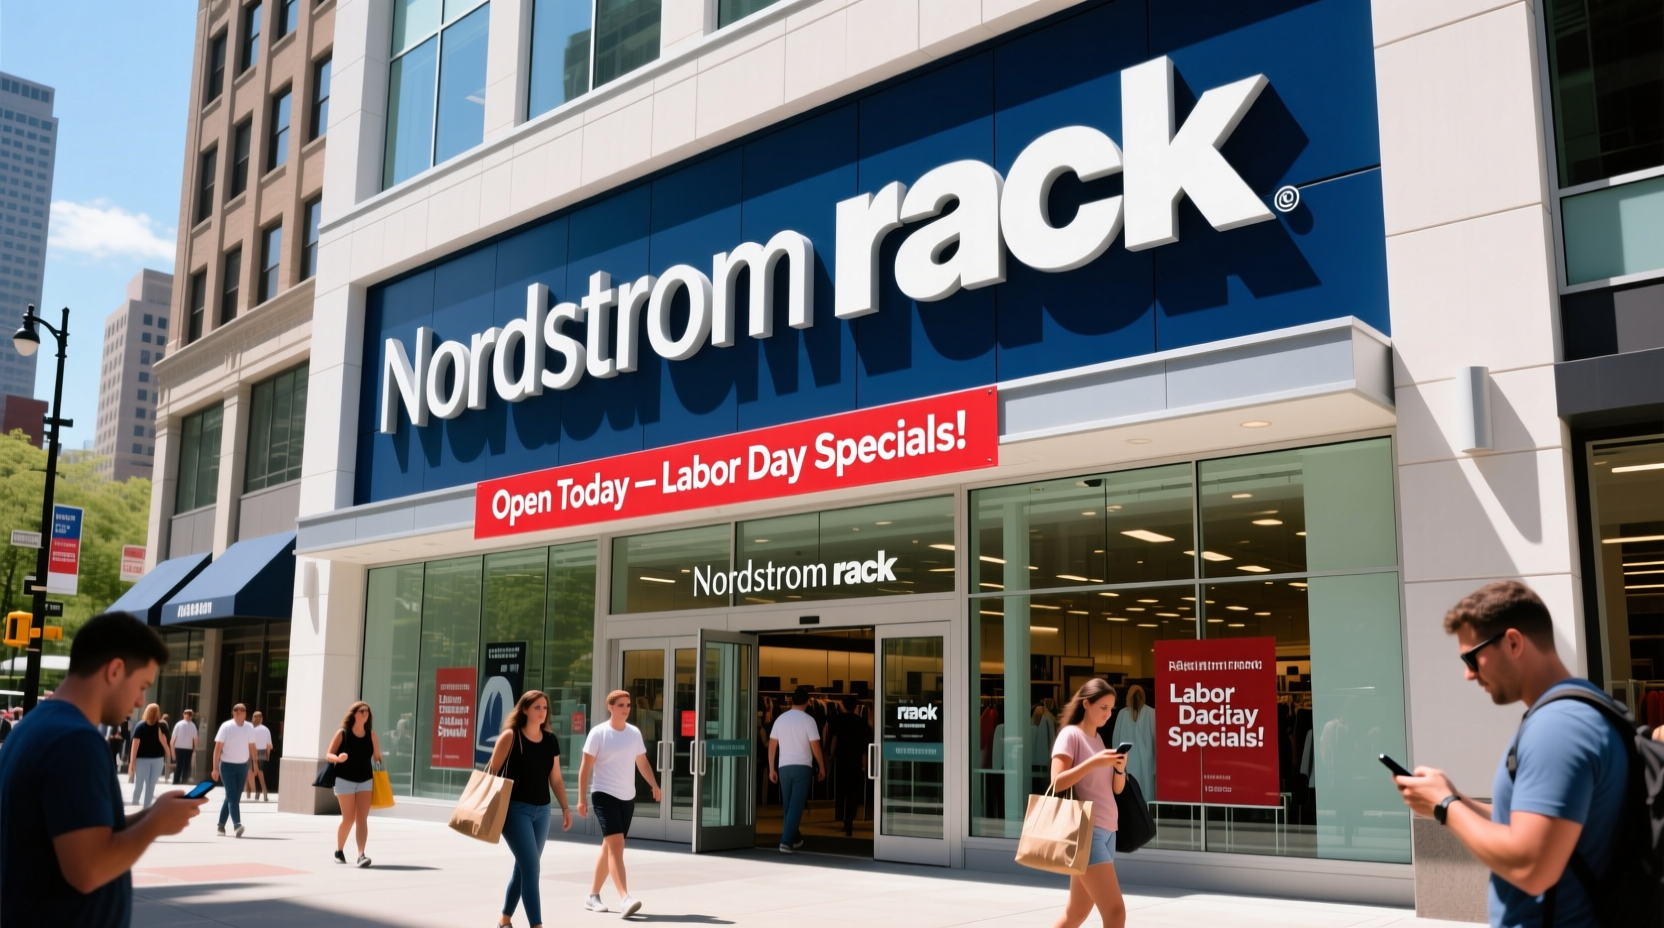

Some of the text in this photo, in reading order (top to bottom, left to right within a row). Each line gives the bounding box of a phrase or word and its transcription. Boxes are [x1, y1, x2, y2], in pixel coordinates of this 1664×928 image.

[380, 229, 814, 434] Nordstrom
[834, 55, 1277, 319] rack
[491, 487, 552, 527] Open
[556, 472, 630, 511] Today
[662, 453, 742, 494] Labor
[747, 443, 808, 485] Day
[814, 409, 967, 477] Specials!
[693, 550, 898, 597] Nordstrom rack
[1169, 682, 1235, 703] Labor
[1168, 726, 1265, 752] Specials!
